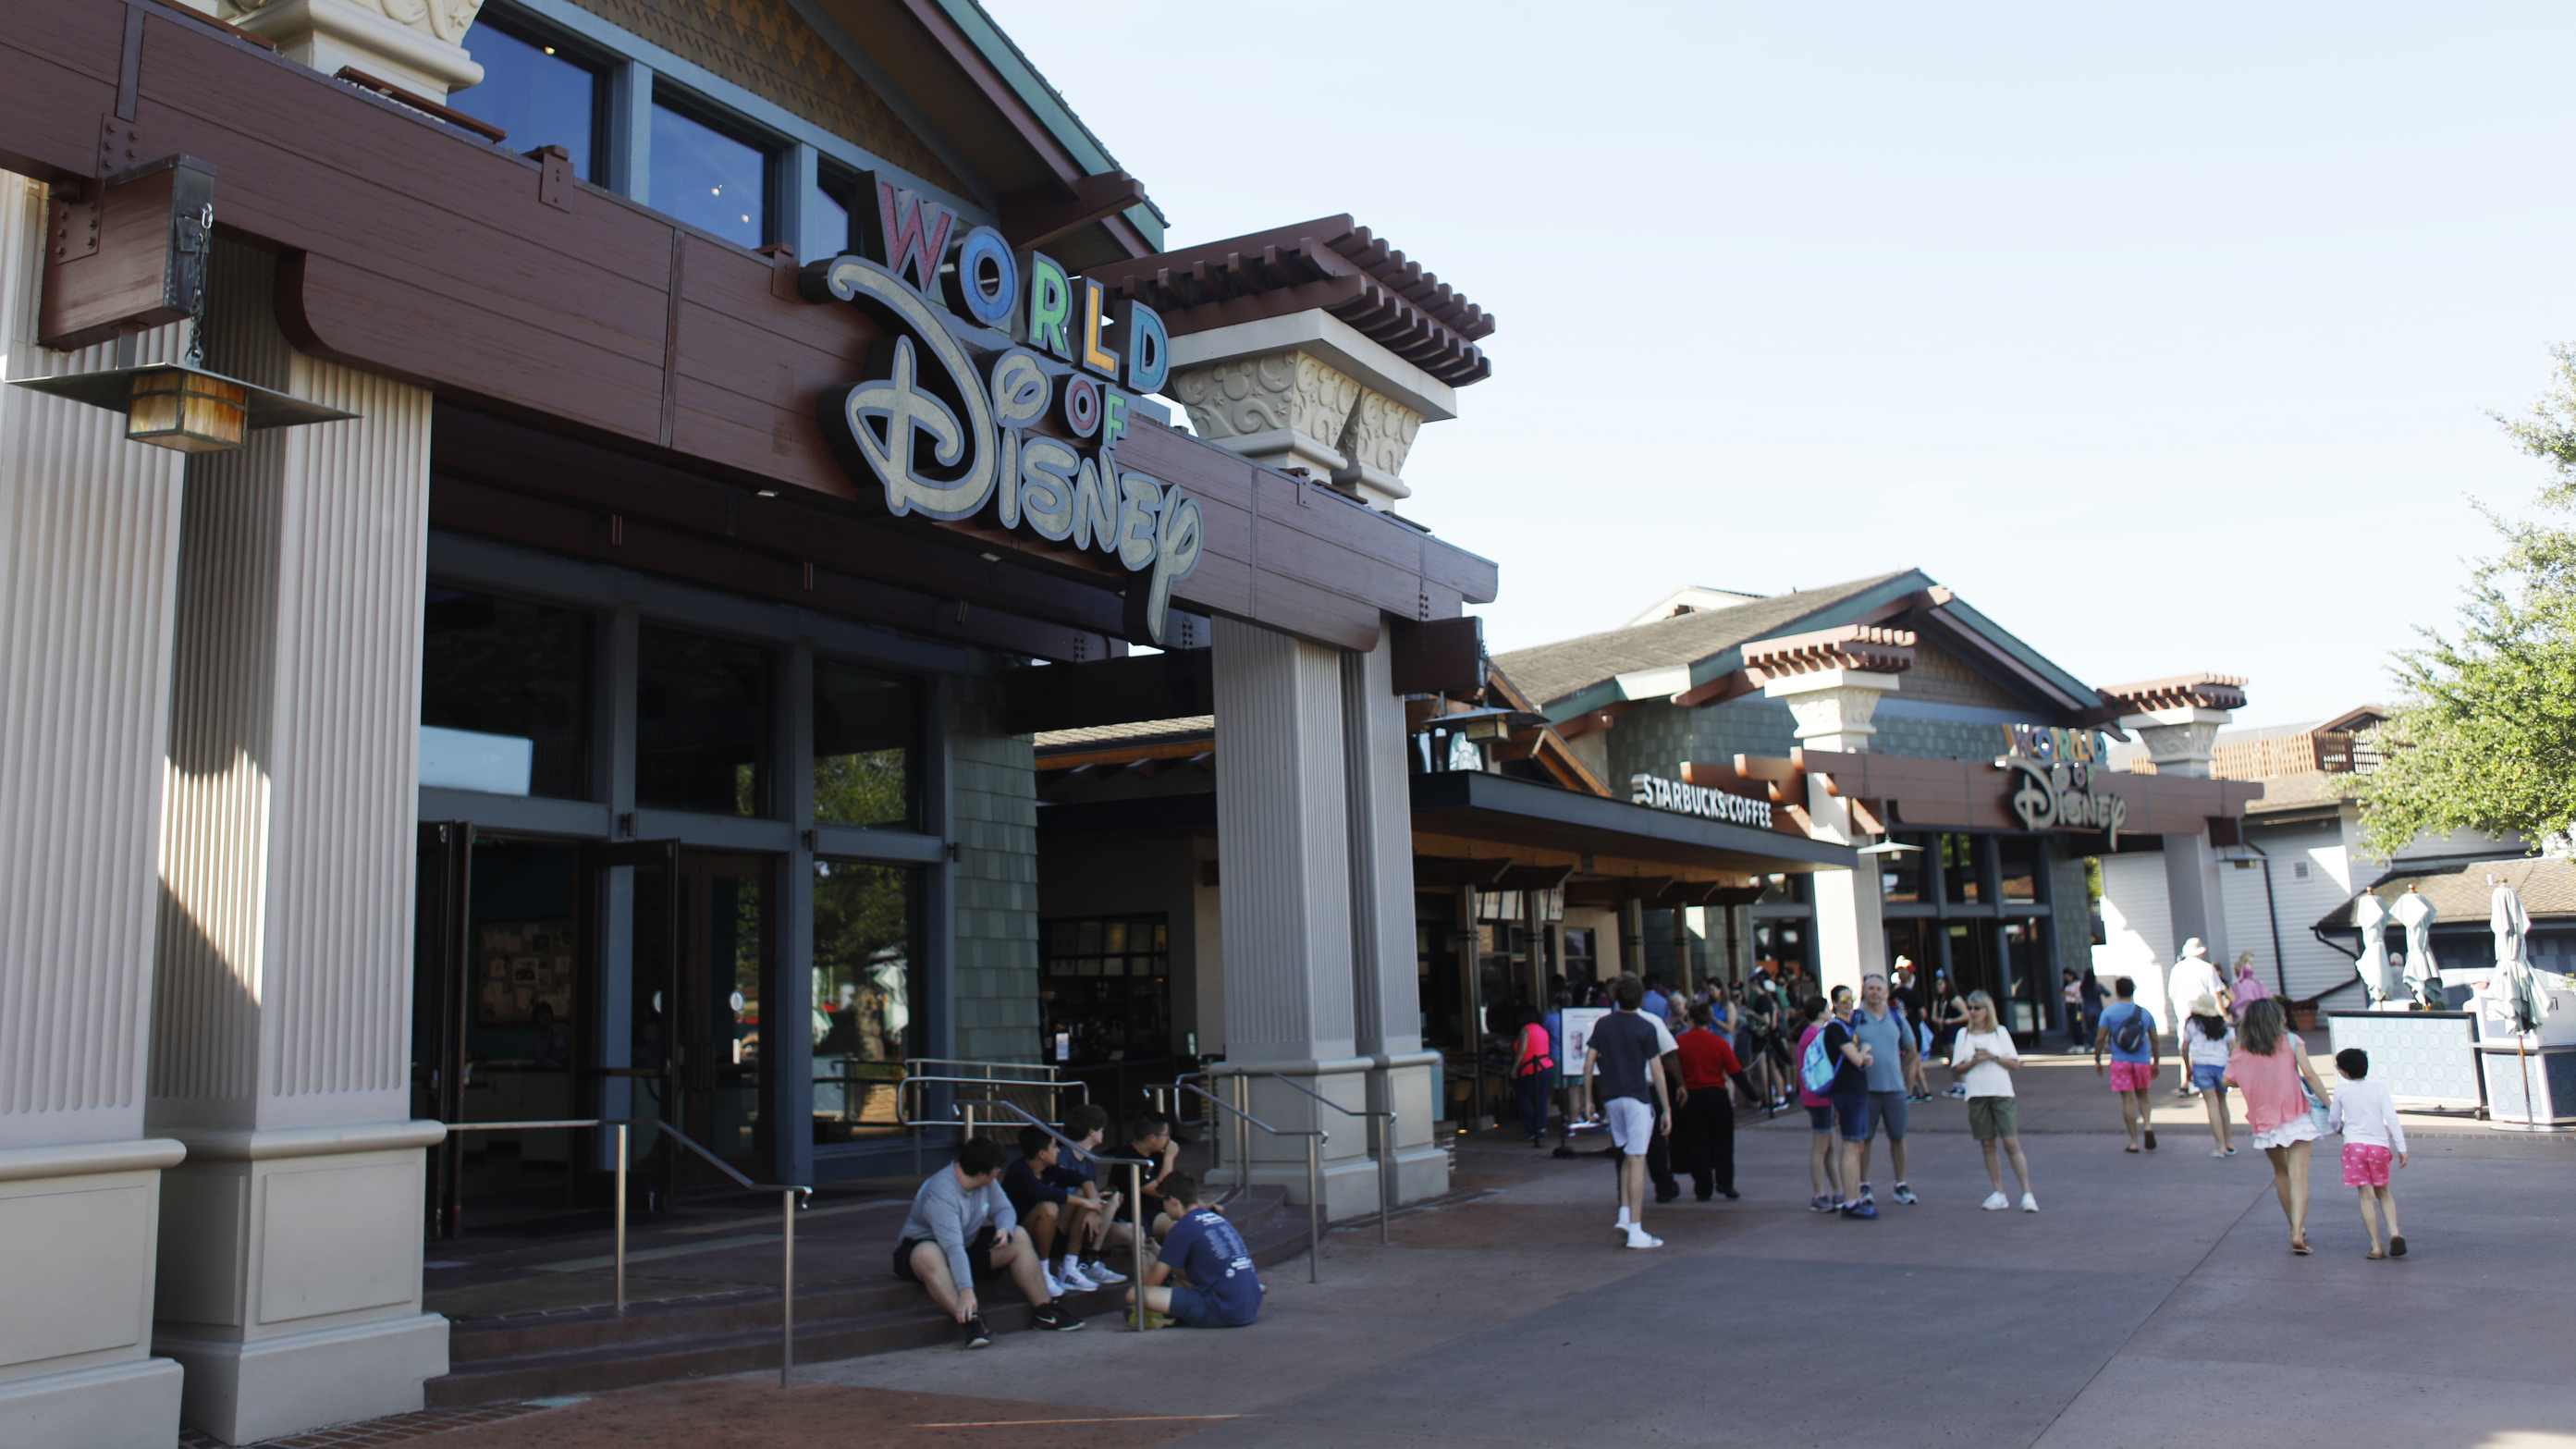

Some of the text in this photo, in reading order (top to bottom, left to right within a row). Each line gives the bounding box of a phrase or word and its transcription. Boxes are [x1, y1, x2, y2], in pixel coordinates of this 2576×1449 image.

[873, 170, 1171, 394] WORLD
[1065, 374, 1129, 449] OF
[828, 255, 1203, 645] DISNEY
[2011, 723, 2107, 763] WORLD
[1642, 773, 1773, 829] STARBUCKS COFFEE
[2072, 763, 2096, 789] OF
